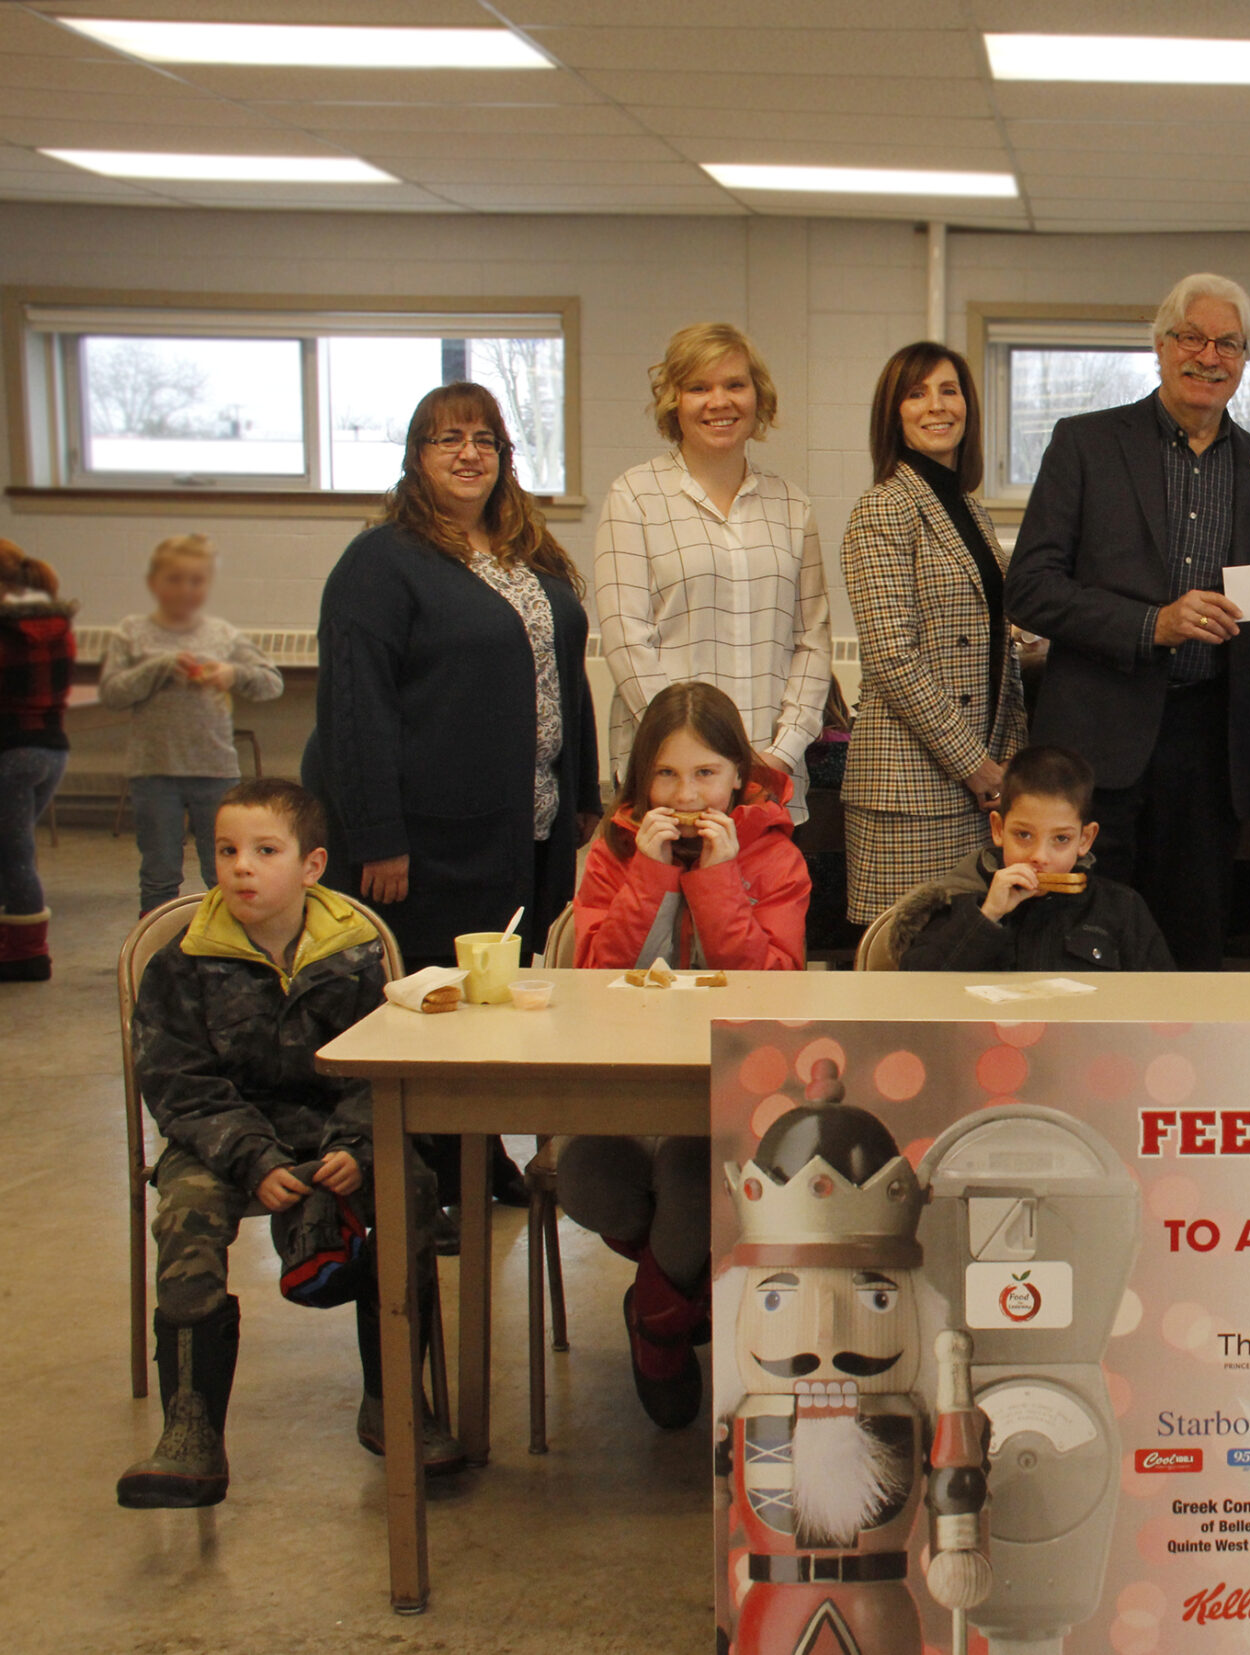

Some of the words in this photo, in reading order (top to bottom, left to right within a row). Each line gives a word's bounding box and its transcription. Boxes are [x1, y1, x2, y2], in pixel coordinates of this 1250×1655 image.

[1164, 1220, 1220, 1252] TO
[1224, 1362, 1250, 1370] PRINCE
[1172, 1499, 1218, 1514] Greek
[1201, 1520, 1214, 1533] of
[1167, 1539, 1211, 1553] Quinte
[1215, 1539, 1249, 1551] West
